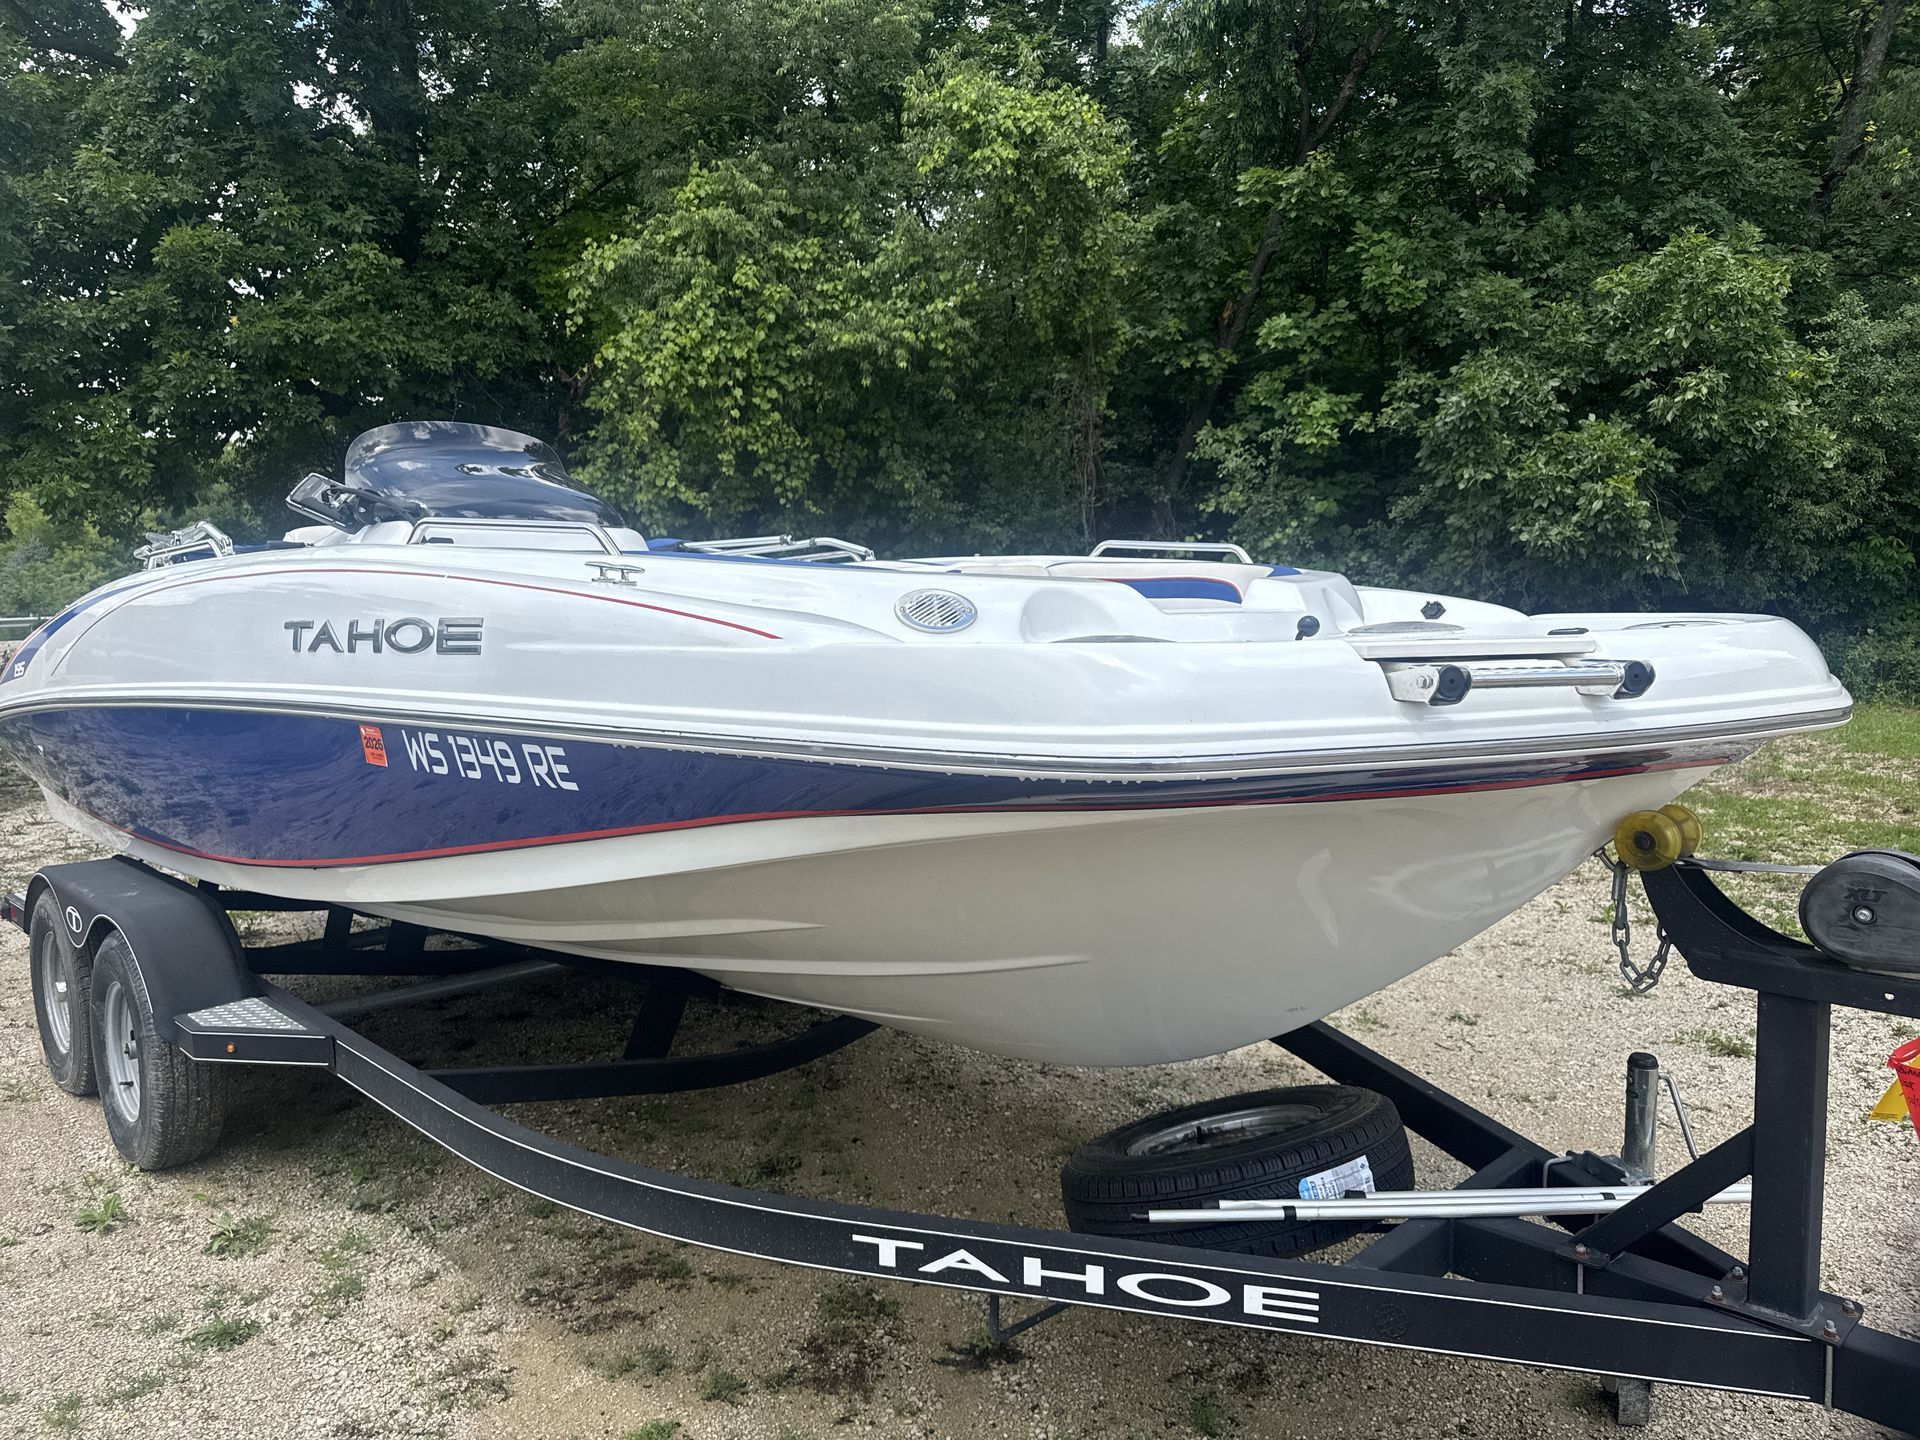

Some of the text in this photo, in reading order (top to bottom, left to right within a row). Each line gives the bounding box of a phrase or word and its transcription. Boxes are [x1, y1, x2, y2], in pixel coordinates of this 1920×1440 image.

[284, 617, 484, 655] TAHOE
[363, 735, 384, 751] 2026
[401, 729, 580, 791] WS 1349 RE
[851, 1234, 1320, 1323] TAHOE
